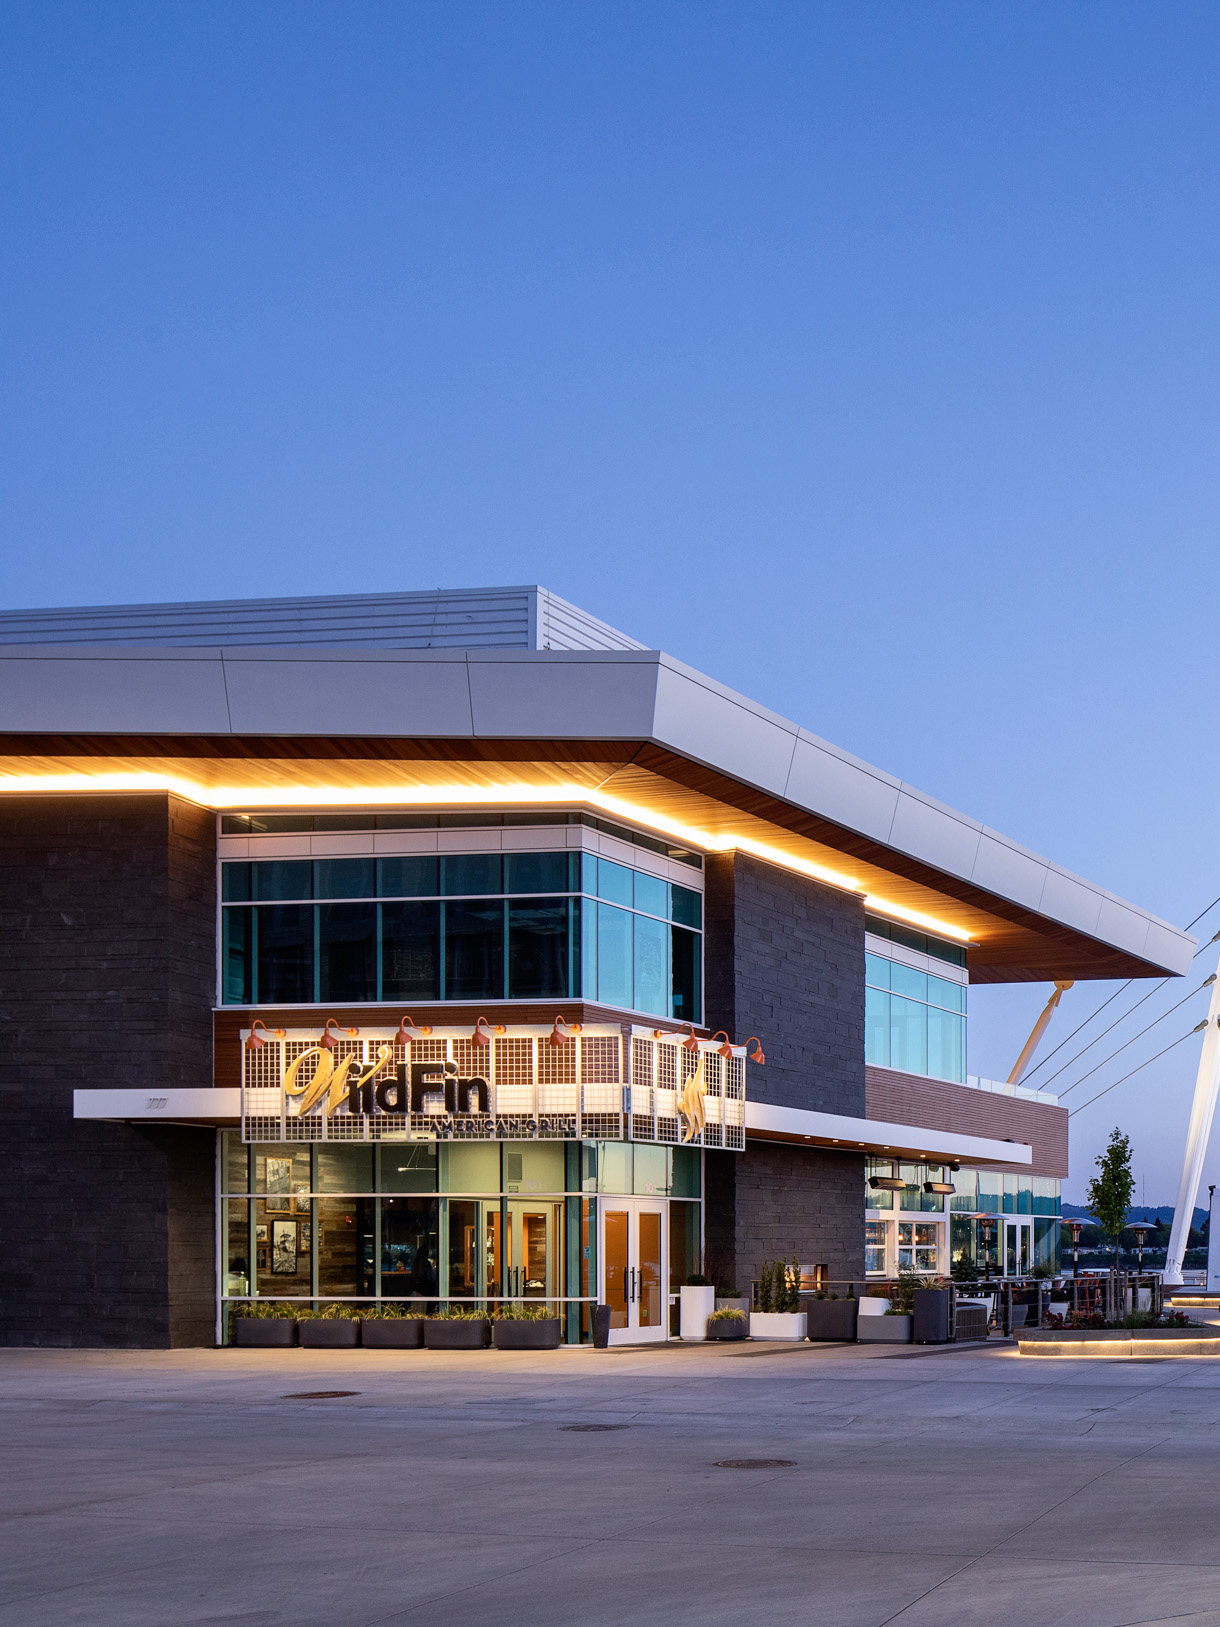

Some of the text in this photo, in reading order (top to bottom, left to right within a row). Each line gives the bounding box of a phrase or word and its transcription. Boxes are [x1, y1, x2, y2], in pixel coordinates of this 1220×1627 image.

[284, 1044, 492, 1118] WildFin
[146, 1098, 168, 1109] 777
[429, 1118, 577, 1133] AMERICAN GRILL
[524, 1179, 542, 1190] 101
[645, 1184, 657, 1193] 101
